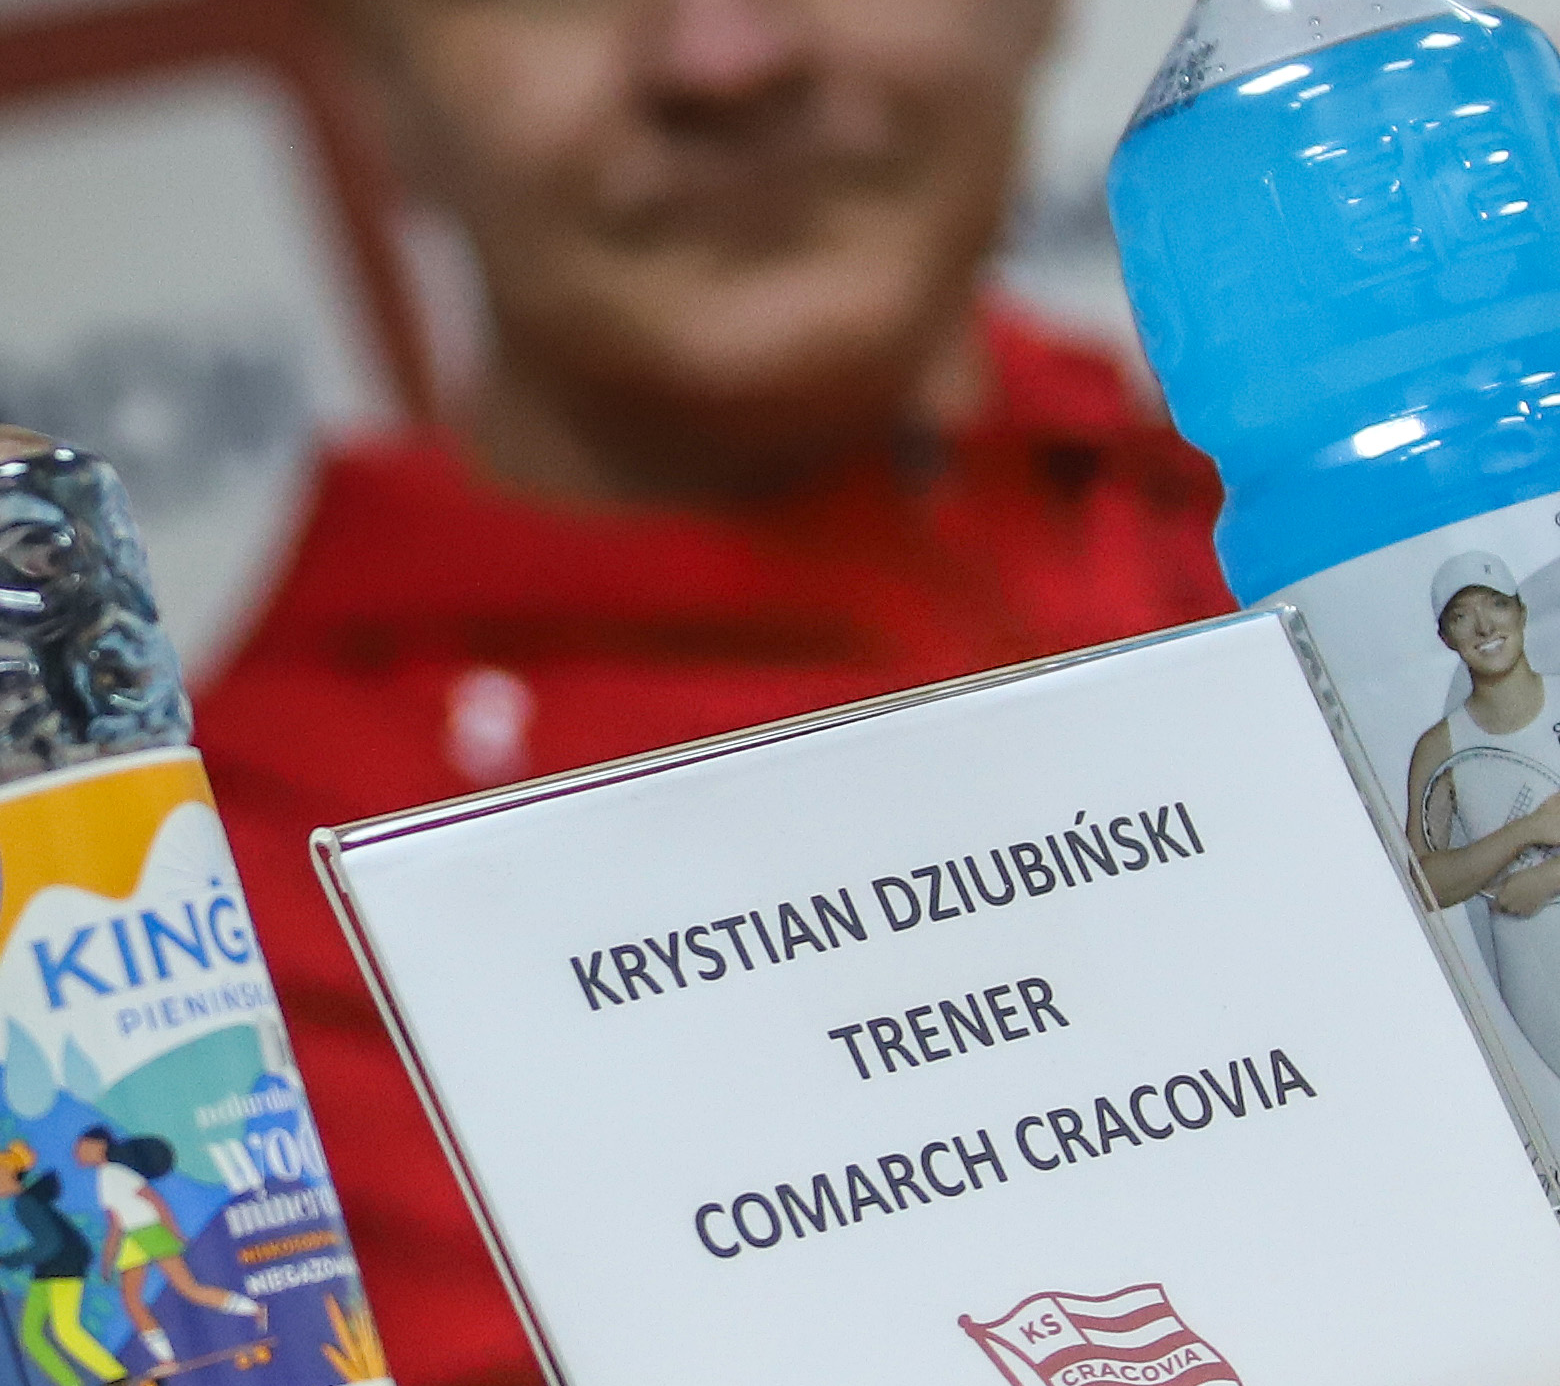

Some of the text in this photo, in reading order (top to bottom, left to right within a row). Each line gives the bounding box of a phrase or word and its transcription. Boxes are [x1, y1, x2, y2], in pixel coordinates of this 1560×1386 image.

[569, 801, 1205, 1011] KRYSTIAN DZIUBIŃSKI
[827, 977, 1070, 1080] TRENER
[694, 1048, 1318, 1259] COMARCH CRACOVIA
[1019, 1313, 1063, 1345] KS
[1061, 1348, 1203, 1386] CRACOVIA
